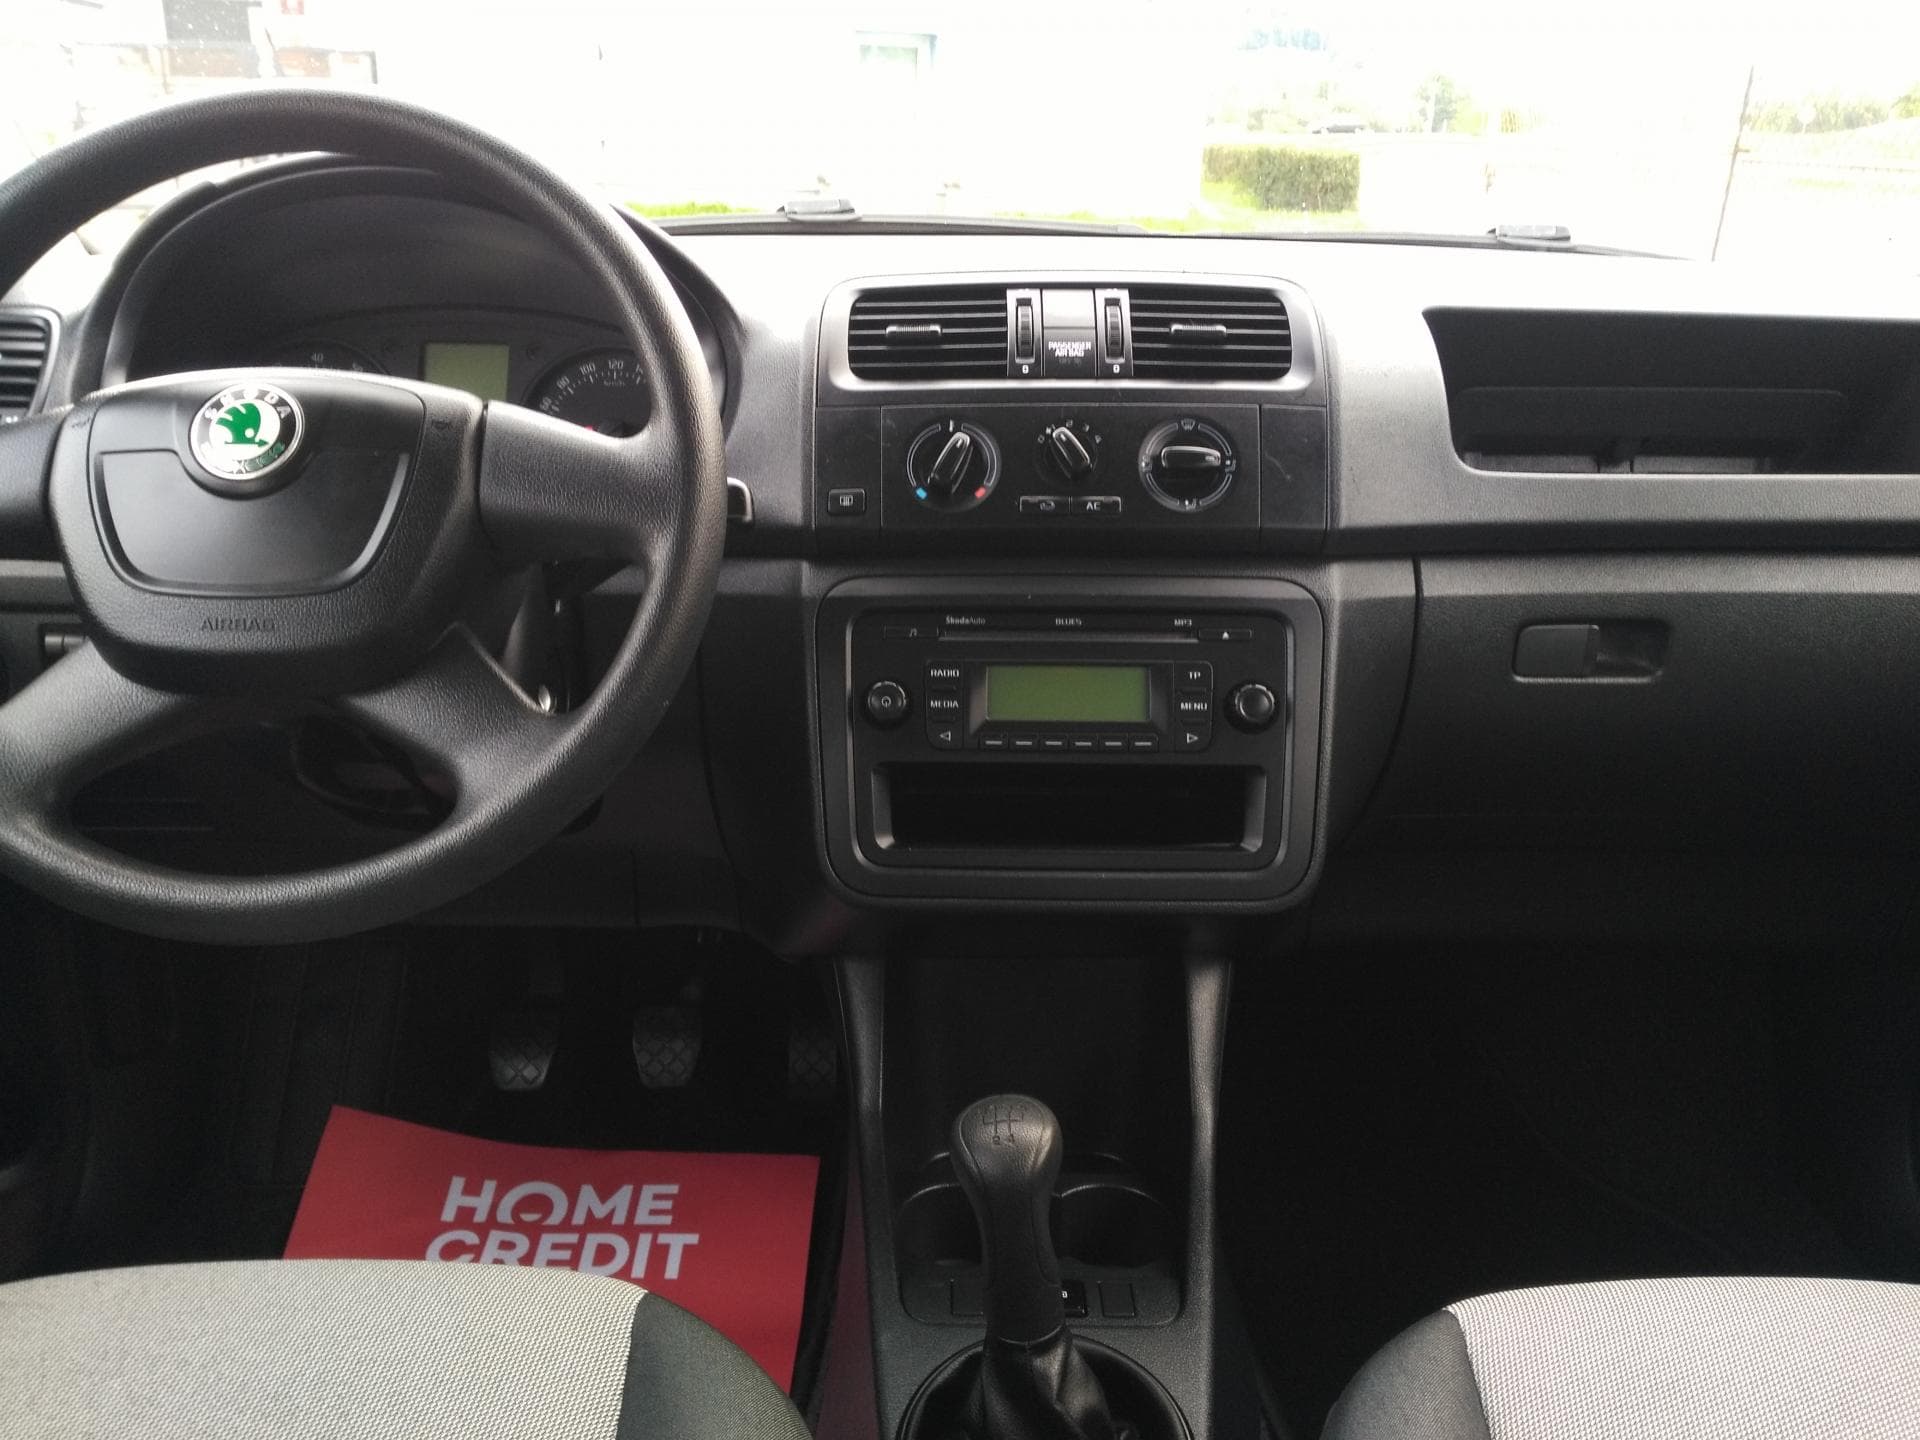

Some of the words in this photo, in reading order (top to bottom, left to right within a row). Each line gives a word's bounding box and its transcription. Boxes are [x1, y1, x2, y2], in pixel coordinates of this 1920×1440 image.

[608, 358, 624, 370] 120
[201, 617, 275, 633] AIRBAG
[1055, 617, 1083, 626] BLUES
[1174, 618, 1193, 627] MP3
[930, 668, 960, 678] RADIO
[930, 700, 959, 709] MEDIA
[1180, 701, 1208, 711] MENU
[440, 1175, 680, 1226] HOME
[425, 1229, 699, 1280] CREDIT
